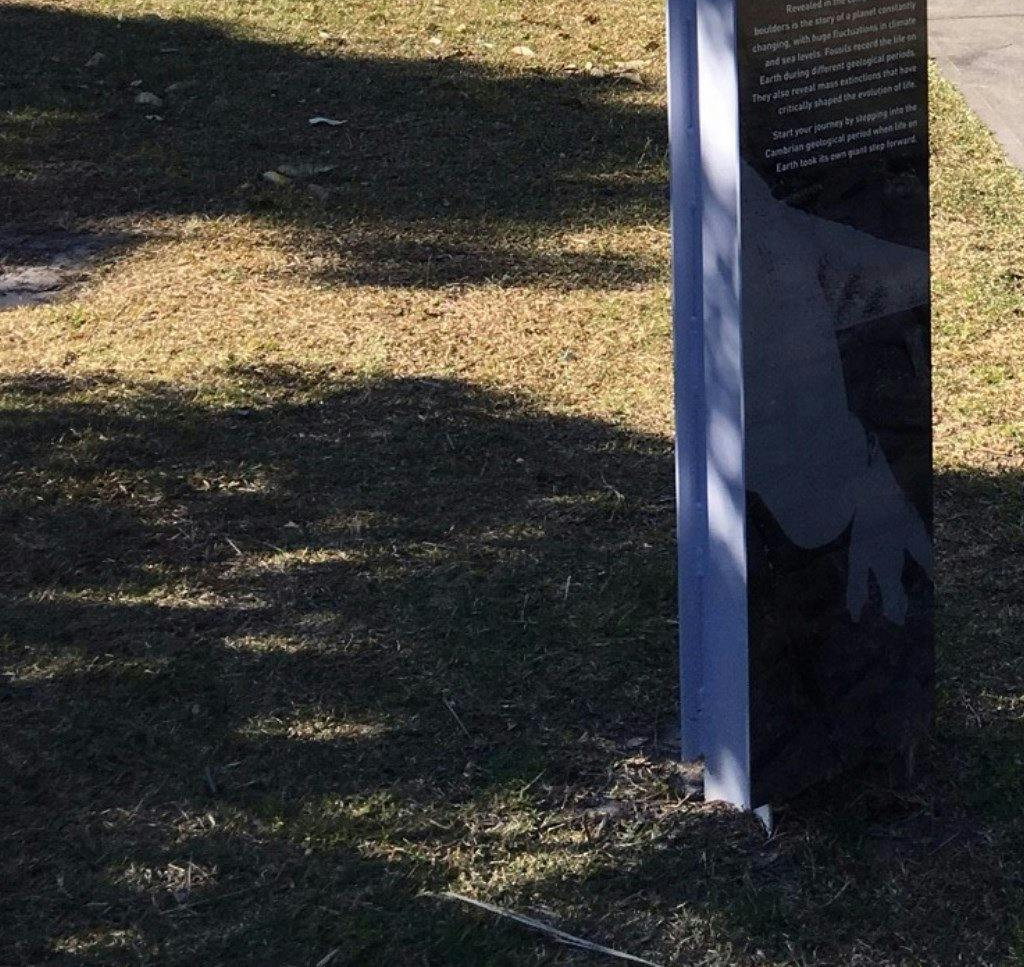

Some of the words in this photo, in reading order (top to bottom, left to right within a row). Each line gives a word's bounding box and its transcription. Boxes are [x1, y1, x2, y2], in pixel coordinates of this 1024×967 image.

[759, 73, 781, 85] Earth
[772, 89, 790, 98] also
[776, 159, 798, 172] Earth
